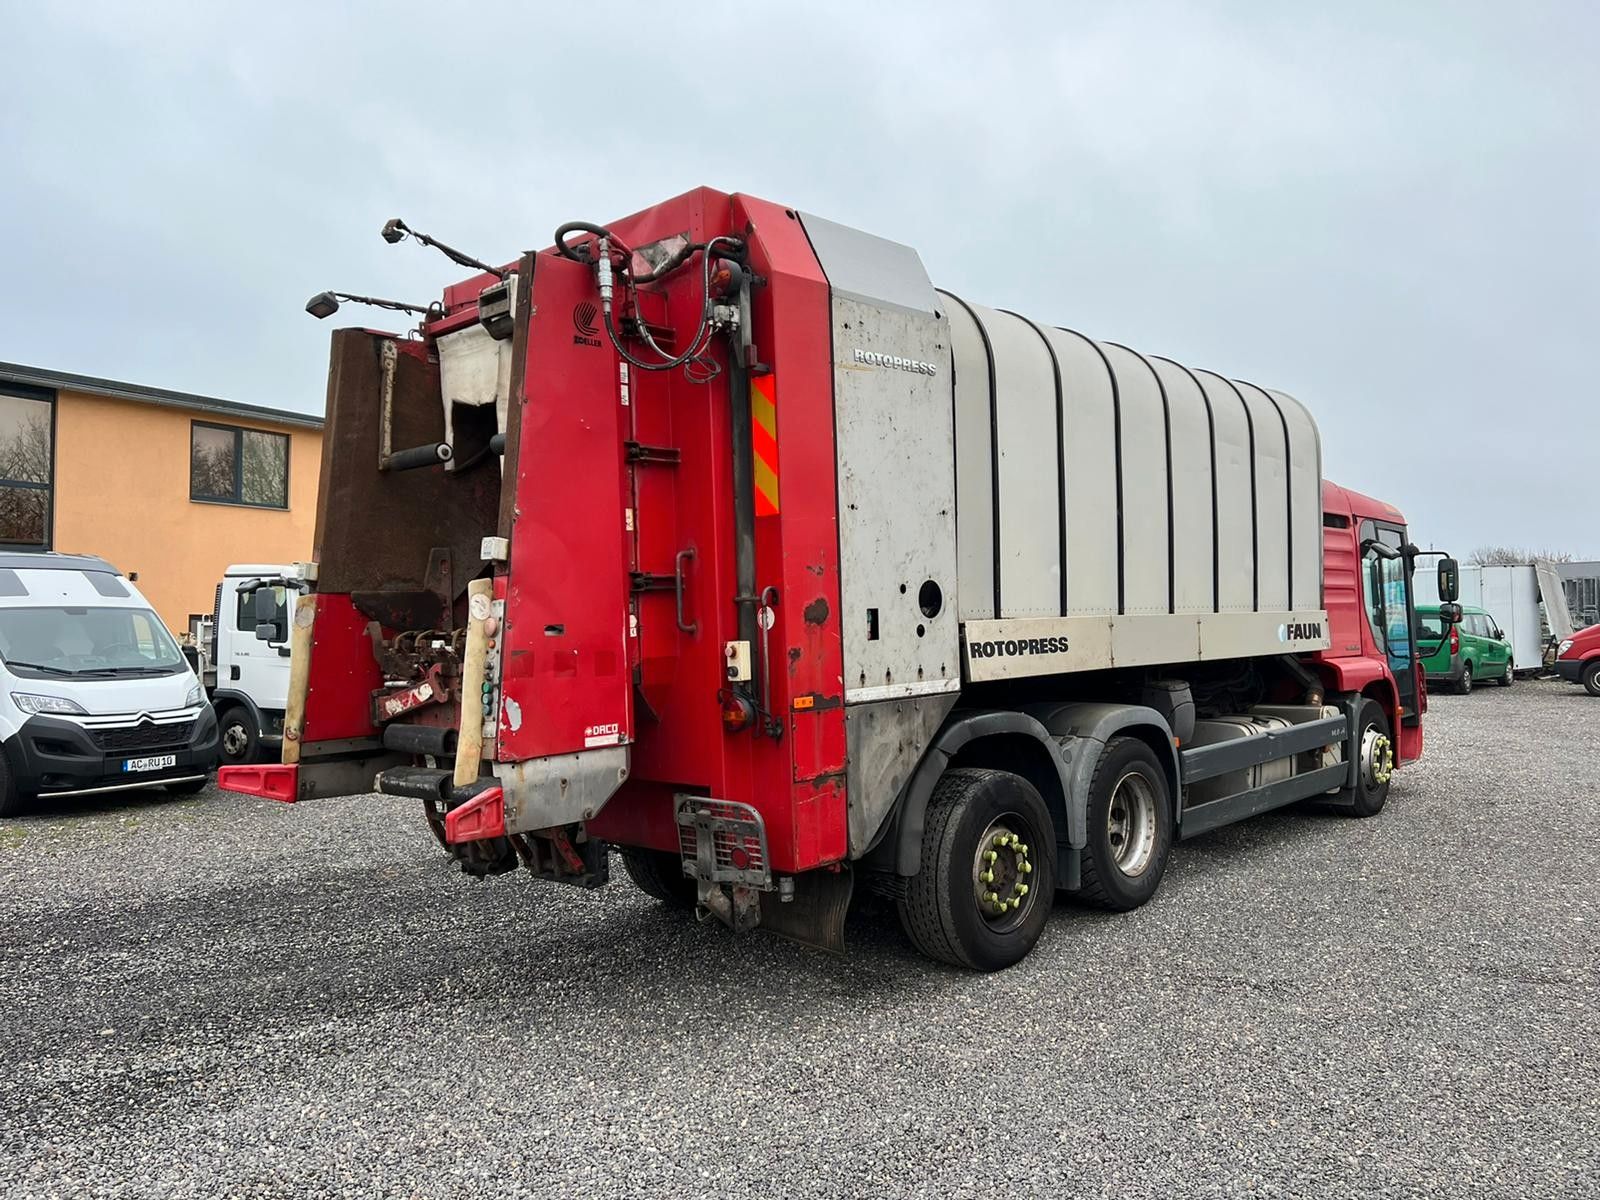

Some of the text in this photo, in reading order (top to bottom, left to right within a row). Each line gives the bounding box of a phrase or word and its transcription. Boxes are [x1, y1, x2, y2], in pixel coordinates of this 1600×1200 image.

[574, 335, 602, 347] ZOELLER
[854, 348, 936, 376] ROTOPRESS
[1287, 623, 1321, 640] FAUN
[970, 637, 1069, 658] ROTOPRESS
[593, 723, 618, 735] DACO
[131, 760, 143, 769] AC
